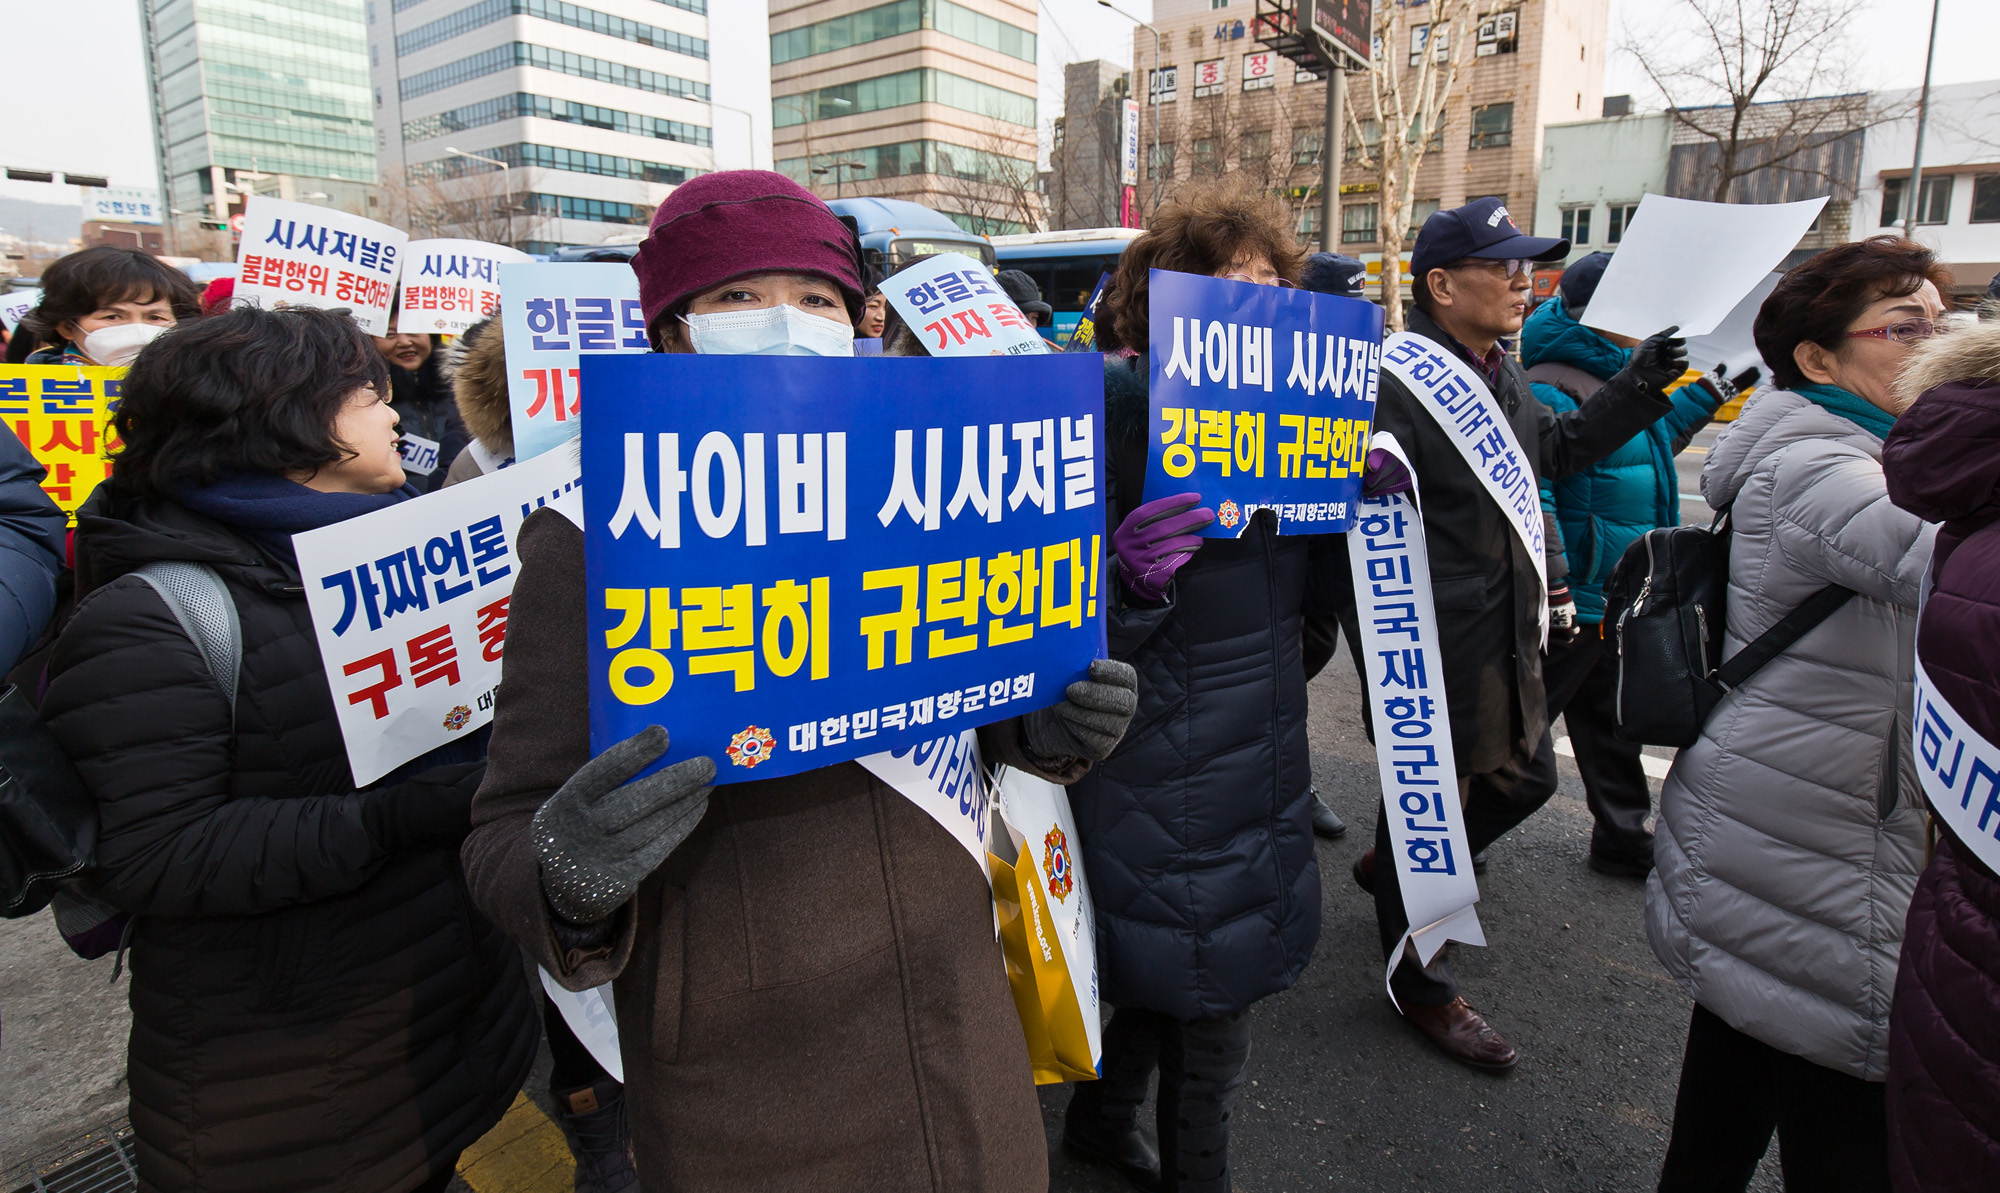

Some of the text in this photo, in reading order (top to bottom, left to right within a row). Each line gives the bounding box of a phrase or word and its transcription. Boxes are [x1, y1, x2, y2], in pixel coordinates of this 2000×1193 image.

[97, 201, 152, 217] 신협보험
[241, 253, 329, 297] 불법행위
[264, 218, 396, 274] 시사저널은
[404, 286, 474, 313] 불법행위
[904, 269, 998, 316] 한글도
[923, 308, 992, 351] 기자
[1164, 316, 1381, 402] 사이비 시사저널
[1161, 407, 1266, 479] 강력히
[607, 413, 1096, 549] 사이비 시사저널
[1244, 502, 1347, 523] 대민국재향군인회
[321, 514, 512, 638] 가짜언론
[604, 534, 1101, 707] 강력히 규탄한다!
[342, 624, 461, 721] 구독
[788, 672, 1036, 754] 대한민국재향군인회
